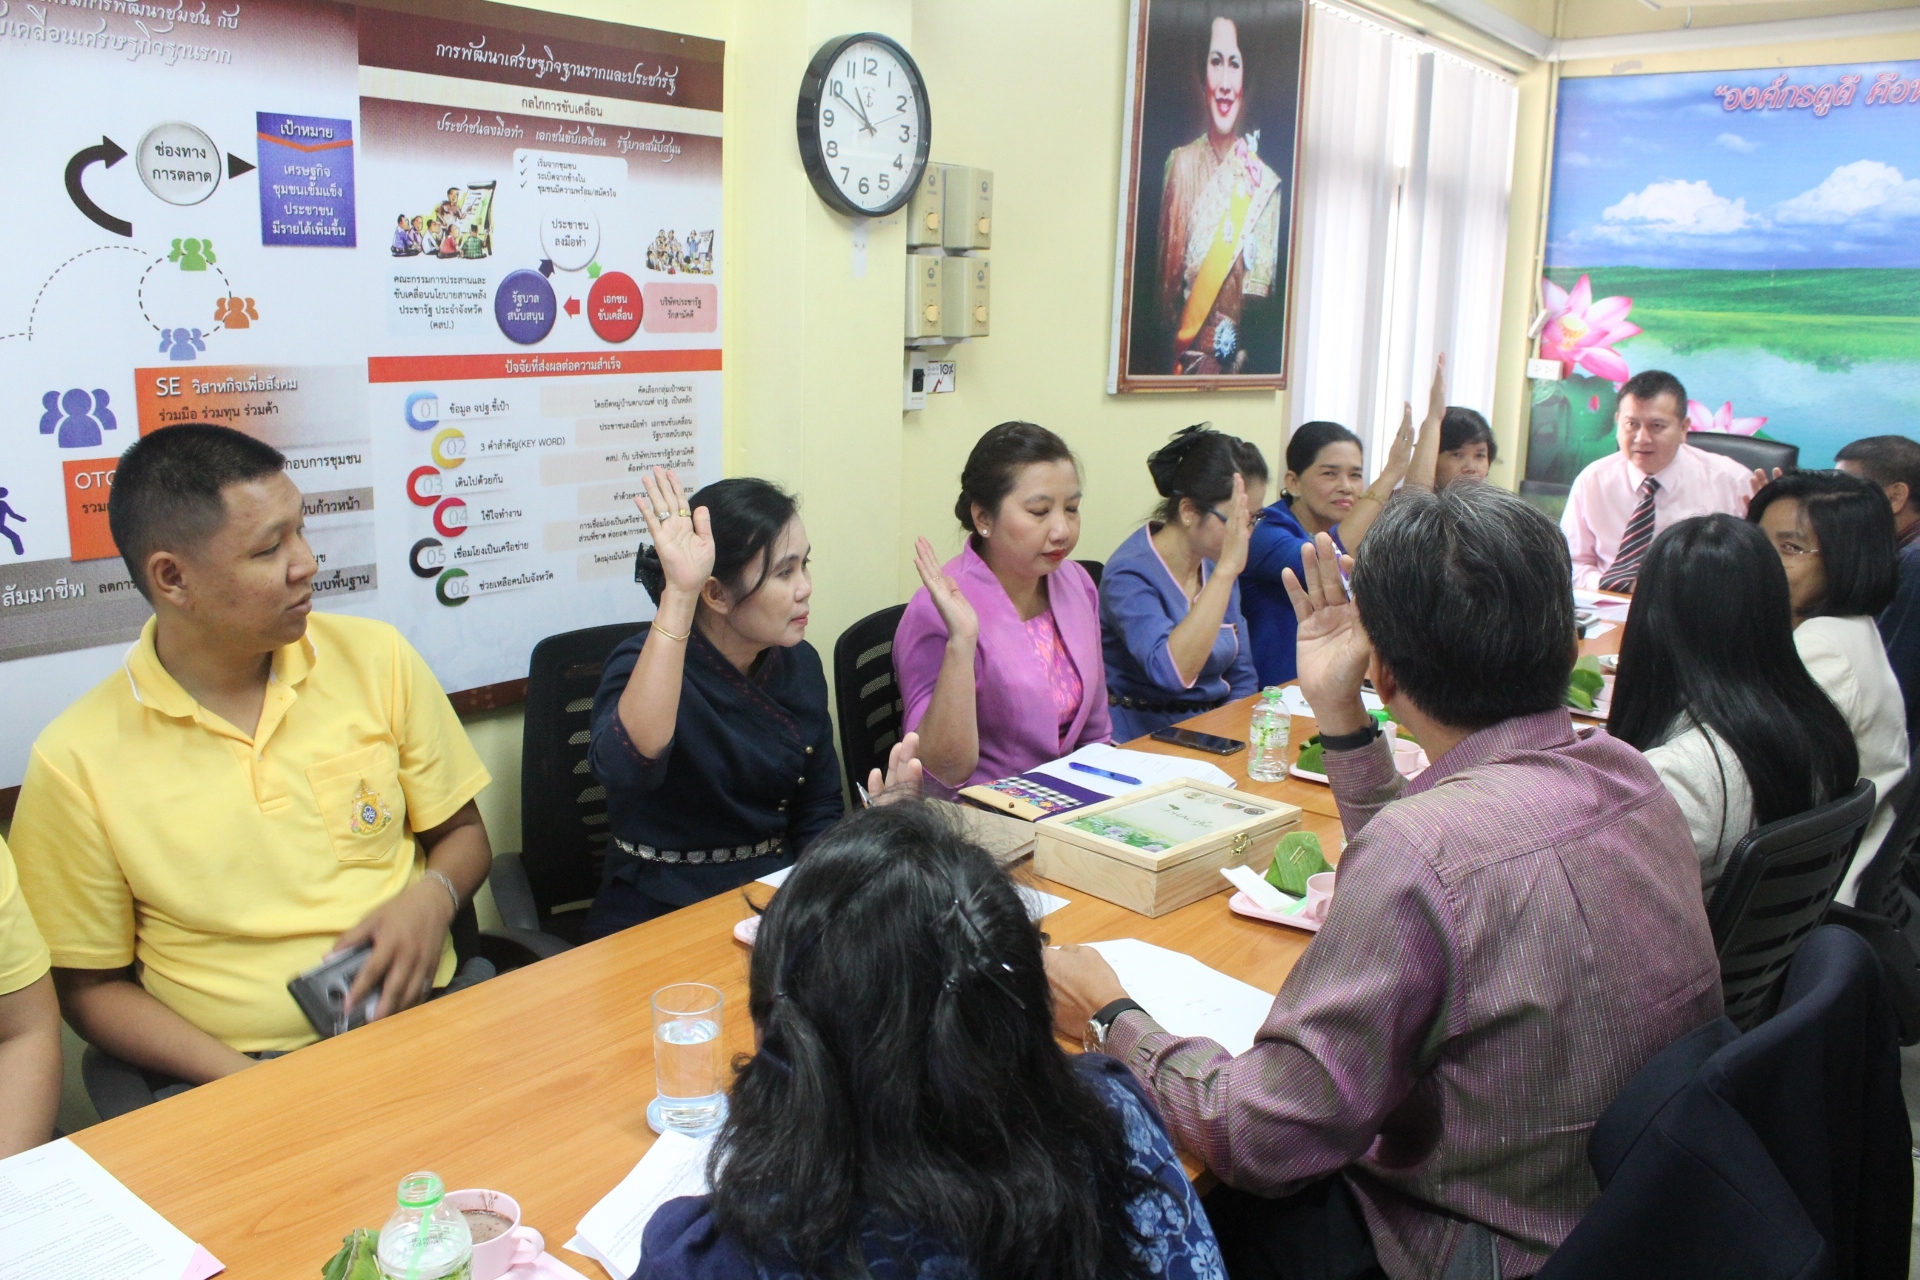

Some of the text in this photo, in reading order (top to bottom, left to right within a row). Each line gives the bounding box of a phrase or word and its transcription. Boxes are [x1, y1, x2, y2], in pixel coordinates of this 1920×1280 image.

[217, 3, 240, 29] กับ
[436, 34, 679, 97] การพัฒนาเศรษฐกิจฐานรากและประชารัฐ
[846, 60, 856, 80] 11
[863, 56, 878, 77] 12
[829, 78, 843, 98] 10
[887, 70, 892, 88] 1
[521, 95, 603, 117] กลไกการขับเคลื่อน
[896, 95, 907, 113] 2
[822, 109, 834, 128] 9
[280, 119, 334, 139] เป้าหมาย
[436, 112, 681, 163] ประชาชนลงมือทำ เอกชนขับเคลื่อน รัฐบาลสนับสนุน
[899, 124, 911, 143] 3
[154, 141, 206, 159] ช่องทาง
[825, 140, 838, 158] 8
[893, 153, 903, 171] 4
[152, 168, 212, 182] การตลาด
[284, 164, 332, 181] เศรษฐกิจ
[840, 166, 850, 185] 7
[878, 173, 890, 191] 5
[272, 181, 343, 199] ชุมชนเข้มแข็ง
[858, 176, 870, 195] 6
[284, 202, 334, 217] ประชาชน
[272, 218, 347, 237] มีรายได้เพิ่มขึ้น
[551, 218, 589, 230] ประชาชน
[555, 234, 587, 247] ลงมือทำ
[394, 275, 487, 285] คณะกรรมการประสานและ
[394, 286, 487, 299] ขับเคลื่อนนโยบายสานพลัง
[512, 290, 540, 308] รัฐบาล
[603, 295, 628, 304] เอกชน
[399, 303, 483, 317] ประชารัฐ ประจำจังหวัด
[507, 308, 545, 324] สนับสนุน
[598, 306, 634, 321] ขับเคลื่อน
[505, 355, 622, 374] ปัจจัยที่ส่งผลต่อความสำเร็จ
[156, 372, 298, 397] SE วิสาหกิจเพื่อสังคม
[159, 401, 279, 422] ร่วมมือ ร่วมทุน ร่วมค้า
[421, 397, 510, 418] 01 ข้อมูล จปฐ.ชี้เป้า
[447, 438, 467, 455] 02
[480, 443, 486, 451] 3
[538, 436, 566, 447] WORD)
[282, 453, 362, 471] กอบการชุมชน
[423, 473, 504, 494] 03 เดินไปด้วยกัน
[303, 496, 360, 515] บก้าวหน้า
[481, 508, 522, 521] ใช้ใจทำงาน
[426, 541, 529, 565] 05 เชื่อมโยงเป็นเครือข่าย
[2, 577, 85, 607] สัมมาชีพ
[450, 569, 554, 596] 06 ช่วยเหลือคนในจังหวัด
